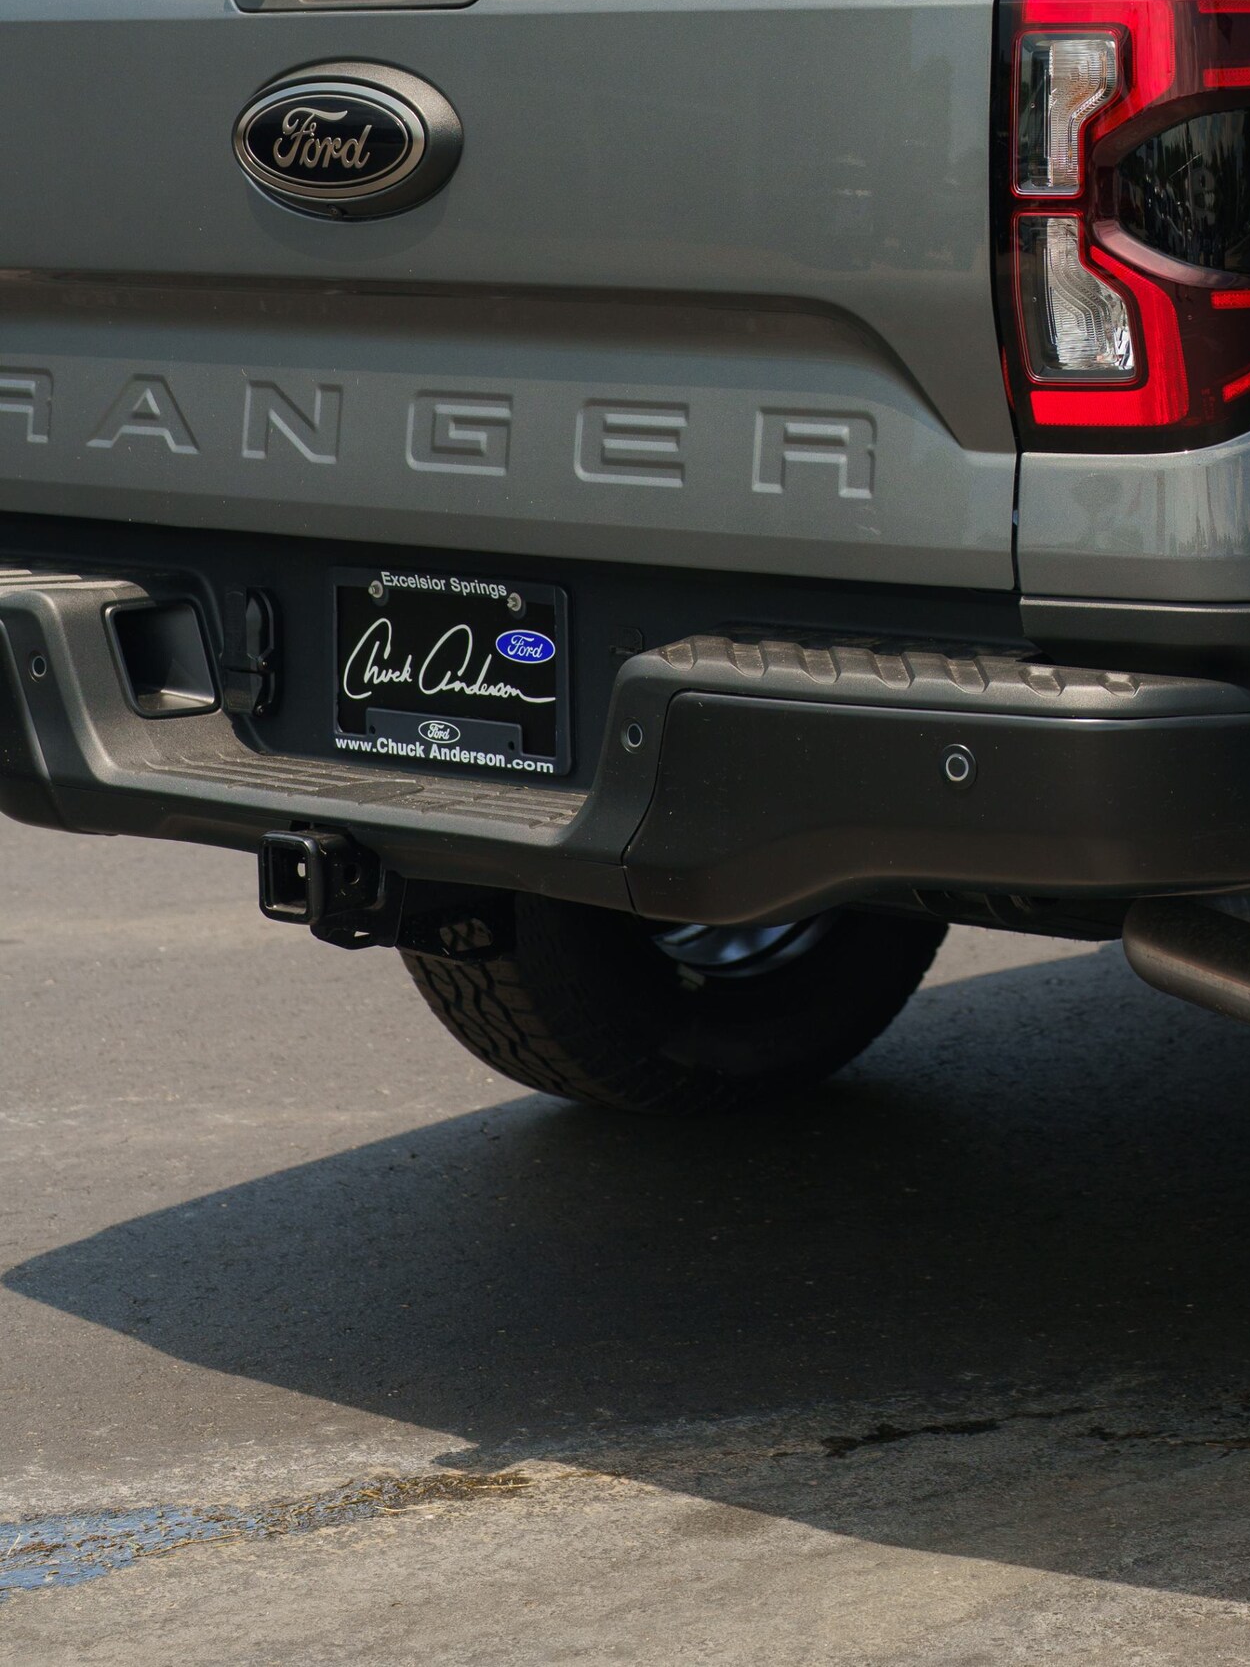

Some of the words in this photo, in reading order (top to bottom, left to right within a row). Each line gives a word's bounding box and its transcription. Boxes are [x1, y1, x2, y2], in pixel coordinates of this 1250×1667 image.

[274, 106, 372, 171] Ford
[381, 571, 446, 591] Excelsior
[450, 577, 507, 599] Springs
[344, 618, 412, 699] Chuck
[419, 624, 556, 703] Anderson
[507, 634, 543, 659] Ford
[427, 723, 450, 739] Ford
[429, 743, 554, 773] Anderson.com
